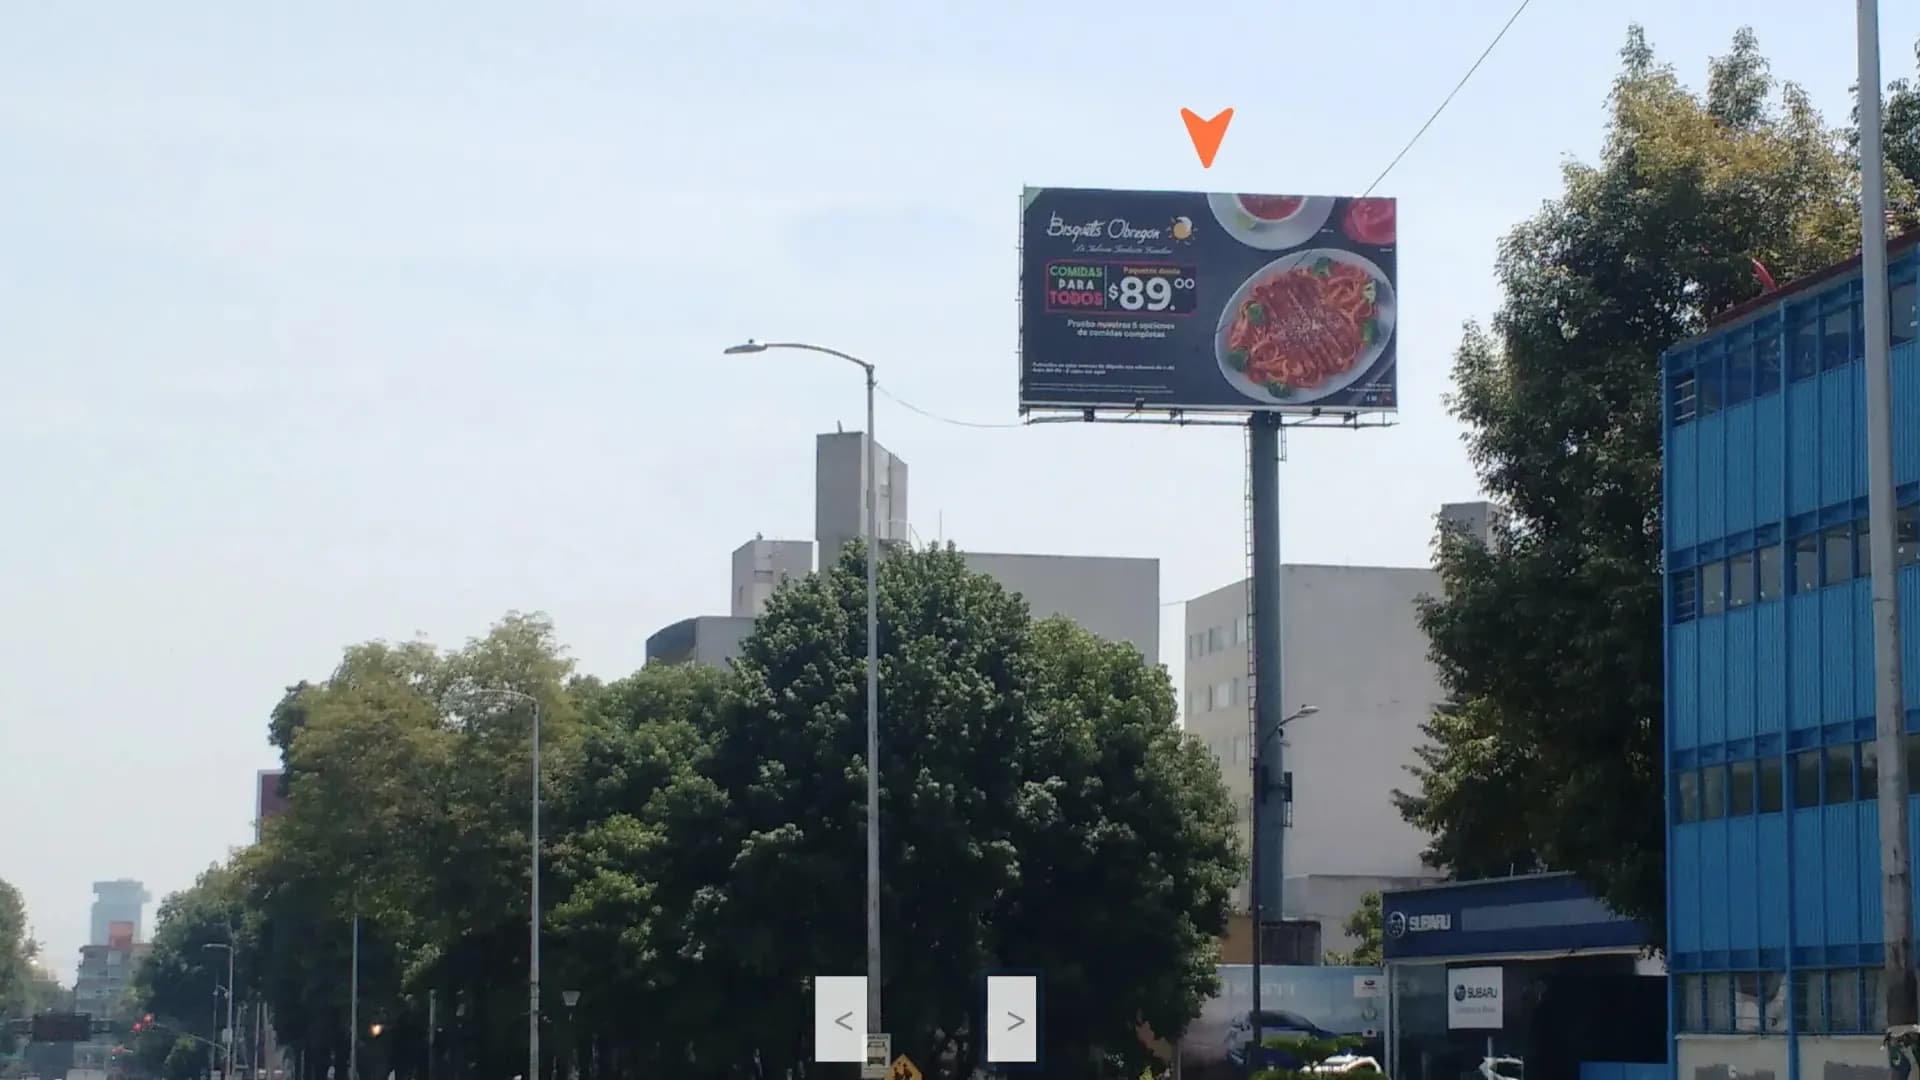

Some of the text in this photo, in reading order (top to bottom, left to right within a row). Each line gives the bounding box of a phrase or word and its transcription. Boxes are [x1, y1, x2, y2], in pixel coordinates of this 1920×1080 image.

[1049, 265, 1103, 278] COMIDAS
[1058, 279, 1095, 290] PARA
[1049, 292, 1103, 305] TODOS
[1077, 328, 1088, 336] de
[1409, 914, 1451, 932] SUBARU
[1467, 986, 1498, 999] SUBARU
